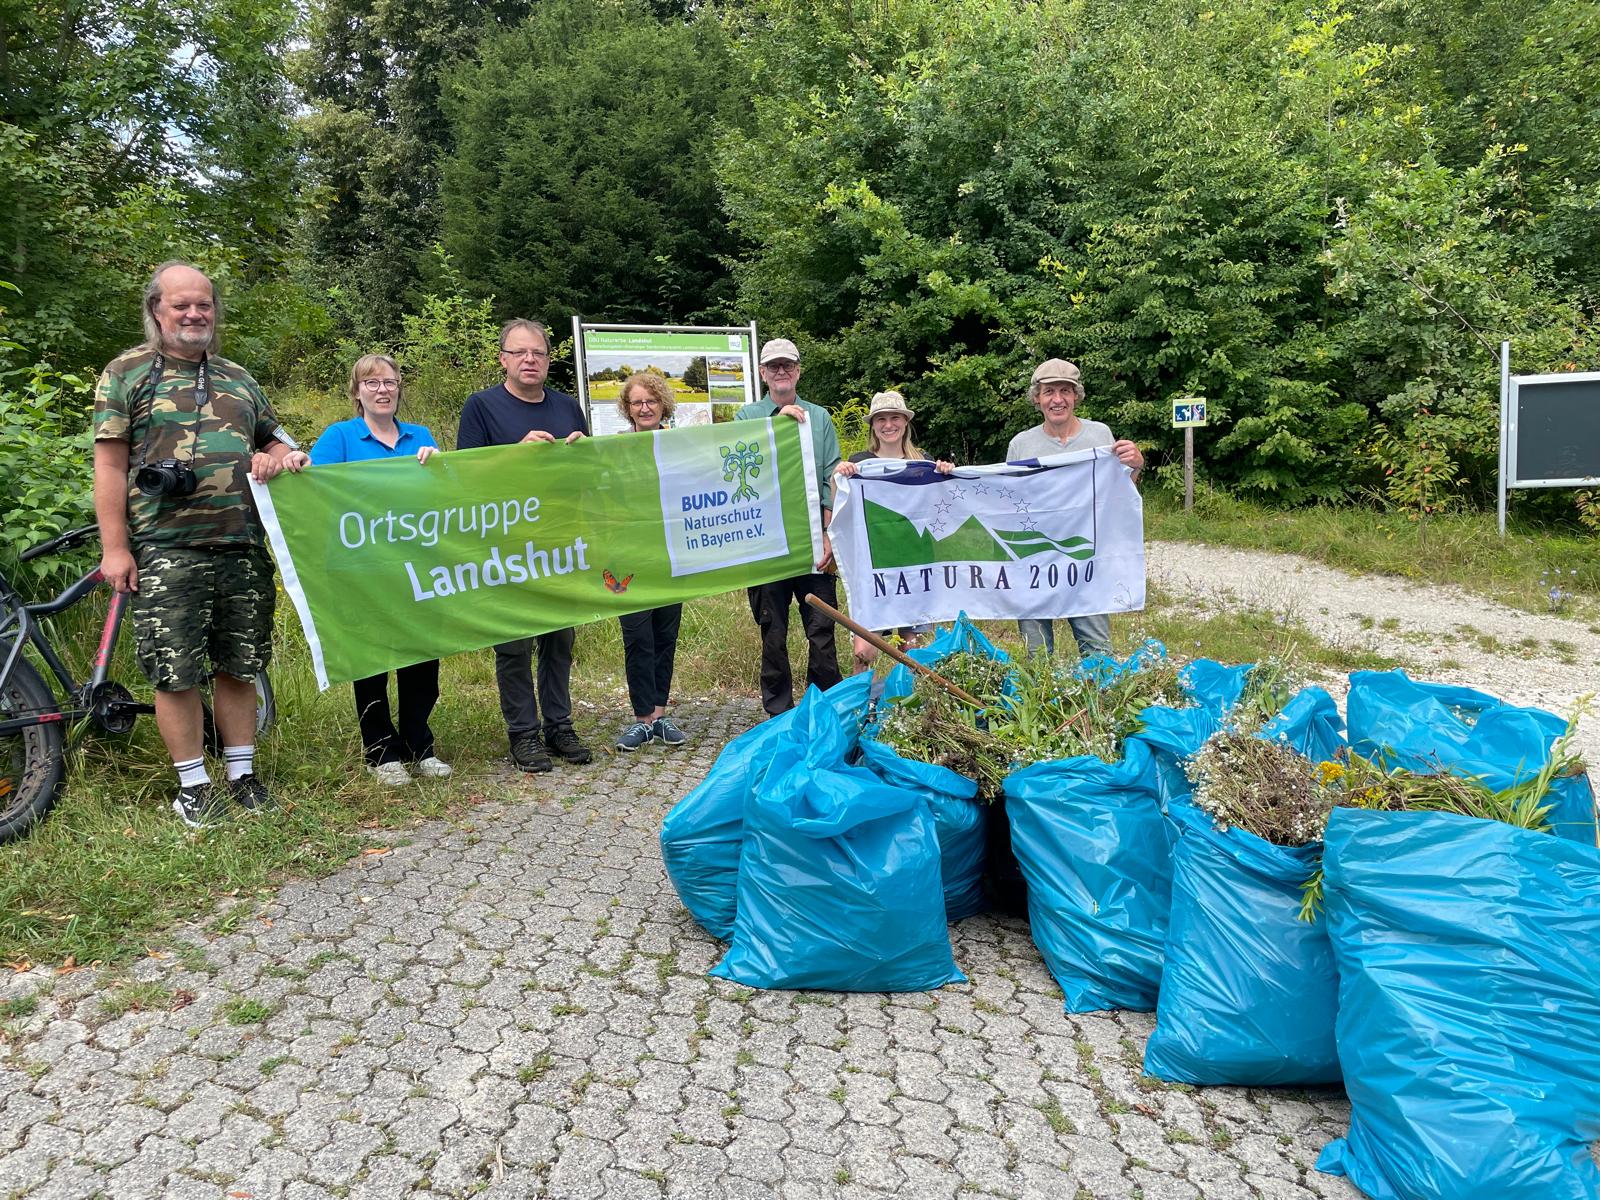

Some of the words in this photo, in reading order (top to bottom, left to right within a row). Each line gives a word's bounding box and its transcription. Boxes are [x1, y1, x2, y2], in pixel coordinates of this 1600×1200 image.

[681, 490, 728, 512] BUND
[339, 496, 540, 549] Ortsgruppe
[684, 507, 762, 531] Naturschutz
[686, 536, 698, 550] in
[701, 530, 744, 548] Bayern
[746, 523, 765, 539] e.V.
[404, 536, 591, 602] Landshut
[872, 565, 1012, 598] NATURA
[1029, 560, 1094, 589] 2000
